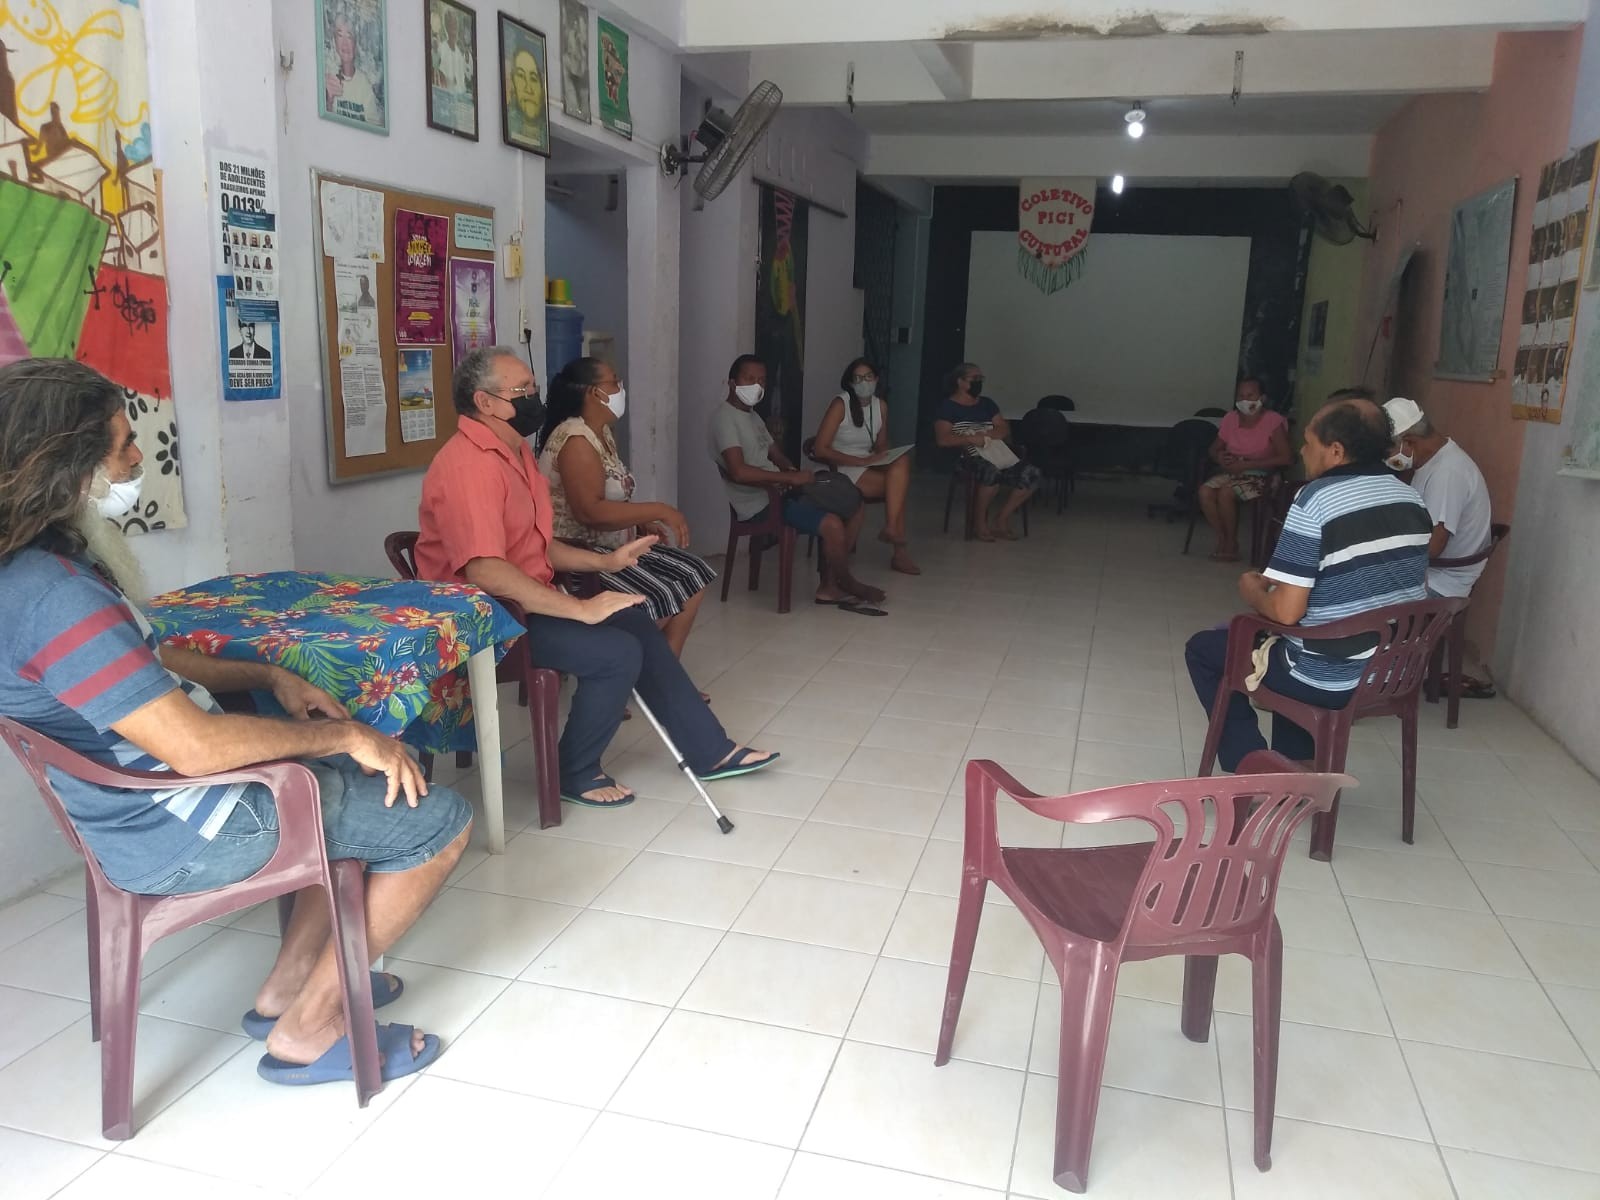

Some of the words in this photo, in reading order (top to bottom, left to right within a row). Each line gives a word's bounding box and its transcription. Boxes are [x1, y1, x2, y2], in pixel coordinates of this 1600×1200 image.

[219, 161, 232, 172] DOS
[232, 164, 240, 174] 21
[240, 165, 266, 179] MILHÕES
[220, 171, 227, 181] DE
[227, 173, 266, 188] ADOLESCENTES
[1021, 188, 1092, 215] COLETIVO
[1037, 211, 1075, 225] PICI
[1020, 228, 1088, 256] CULTURAL
[244, 378, 255, 387] SER
